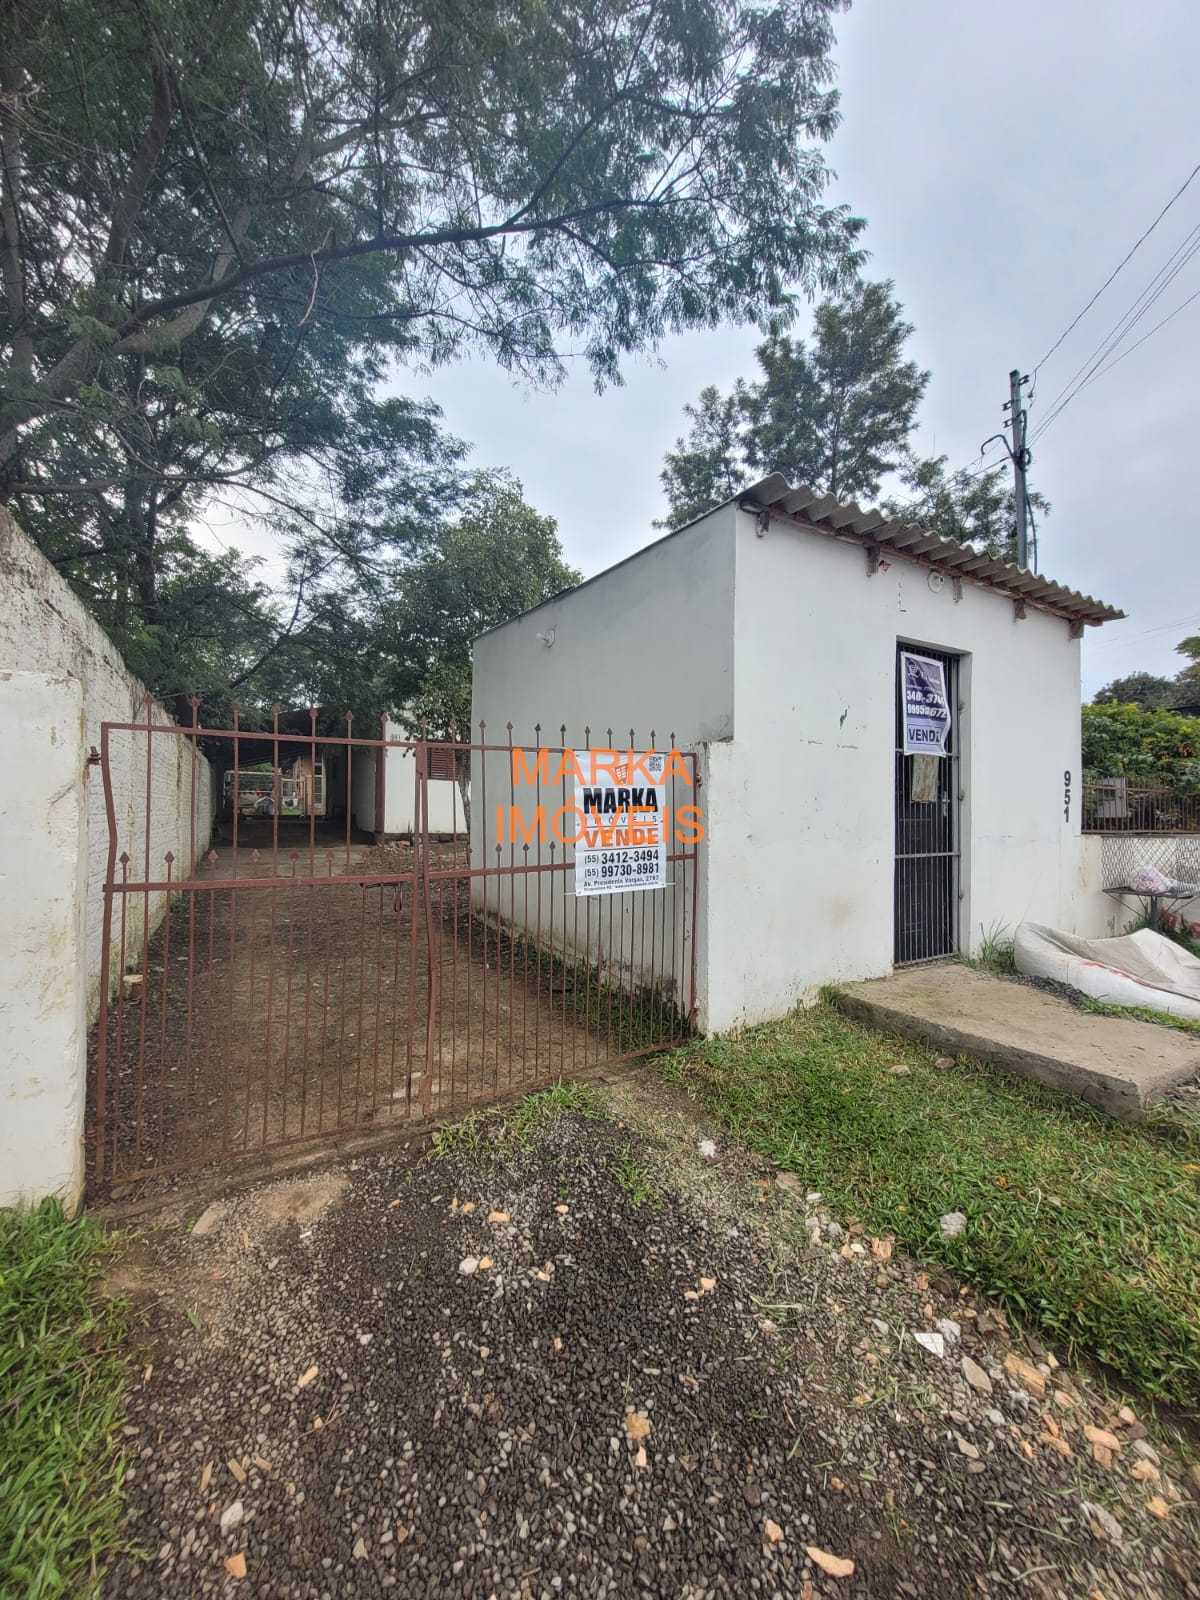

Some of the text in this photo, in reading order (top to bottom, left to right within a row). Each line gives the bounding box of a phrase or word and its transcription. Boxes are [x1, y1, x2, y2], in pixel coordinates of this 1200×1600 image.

[583, 787, 658, 814] MARKA
[1063, 770, 1071, 823] 951
[584, 828, 659, 849] VENDE
[584, 849, 659, 865] (55) 3412-3494
[584, 862, 659, 878] (55) 99730-8981
